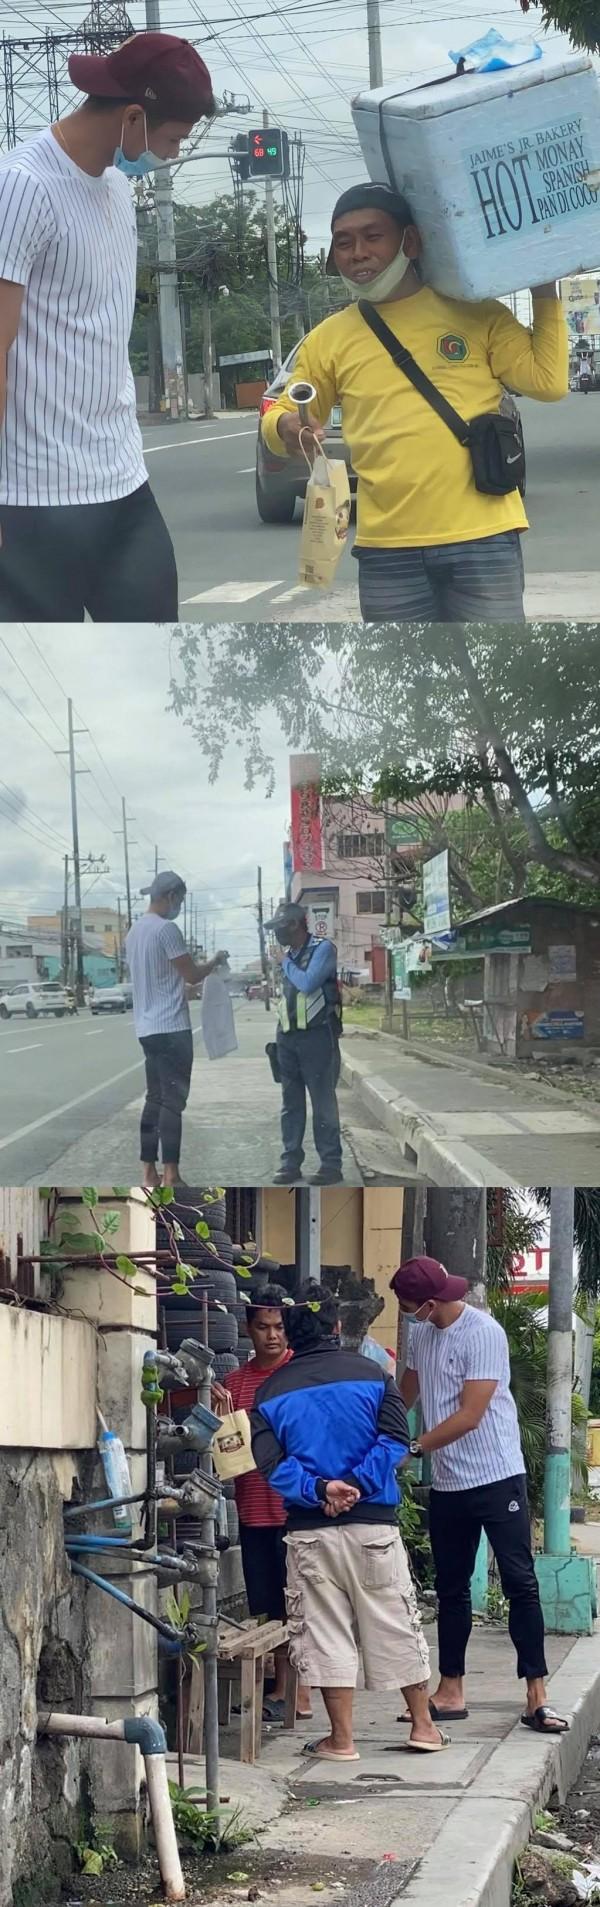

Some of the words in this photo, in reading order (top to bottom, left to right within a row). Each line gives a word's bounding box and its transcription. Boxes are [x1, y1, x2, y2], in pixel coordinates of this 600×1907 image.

[470, 142, 515, 169] JAIME'S
[536, 119, 582, 145] BAKERY
[535, 136, 585, 171] MONAY
[543, 160, 590, 194] SPANISH
[470, 154, 541, 239] HOT
[537, 194, 559, 220] PAN
[556, 190, 571, 214] DI
